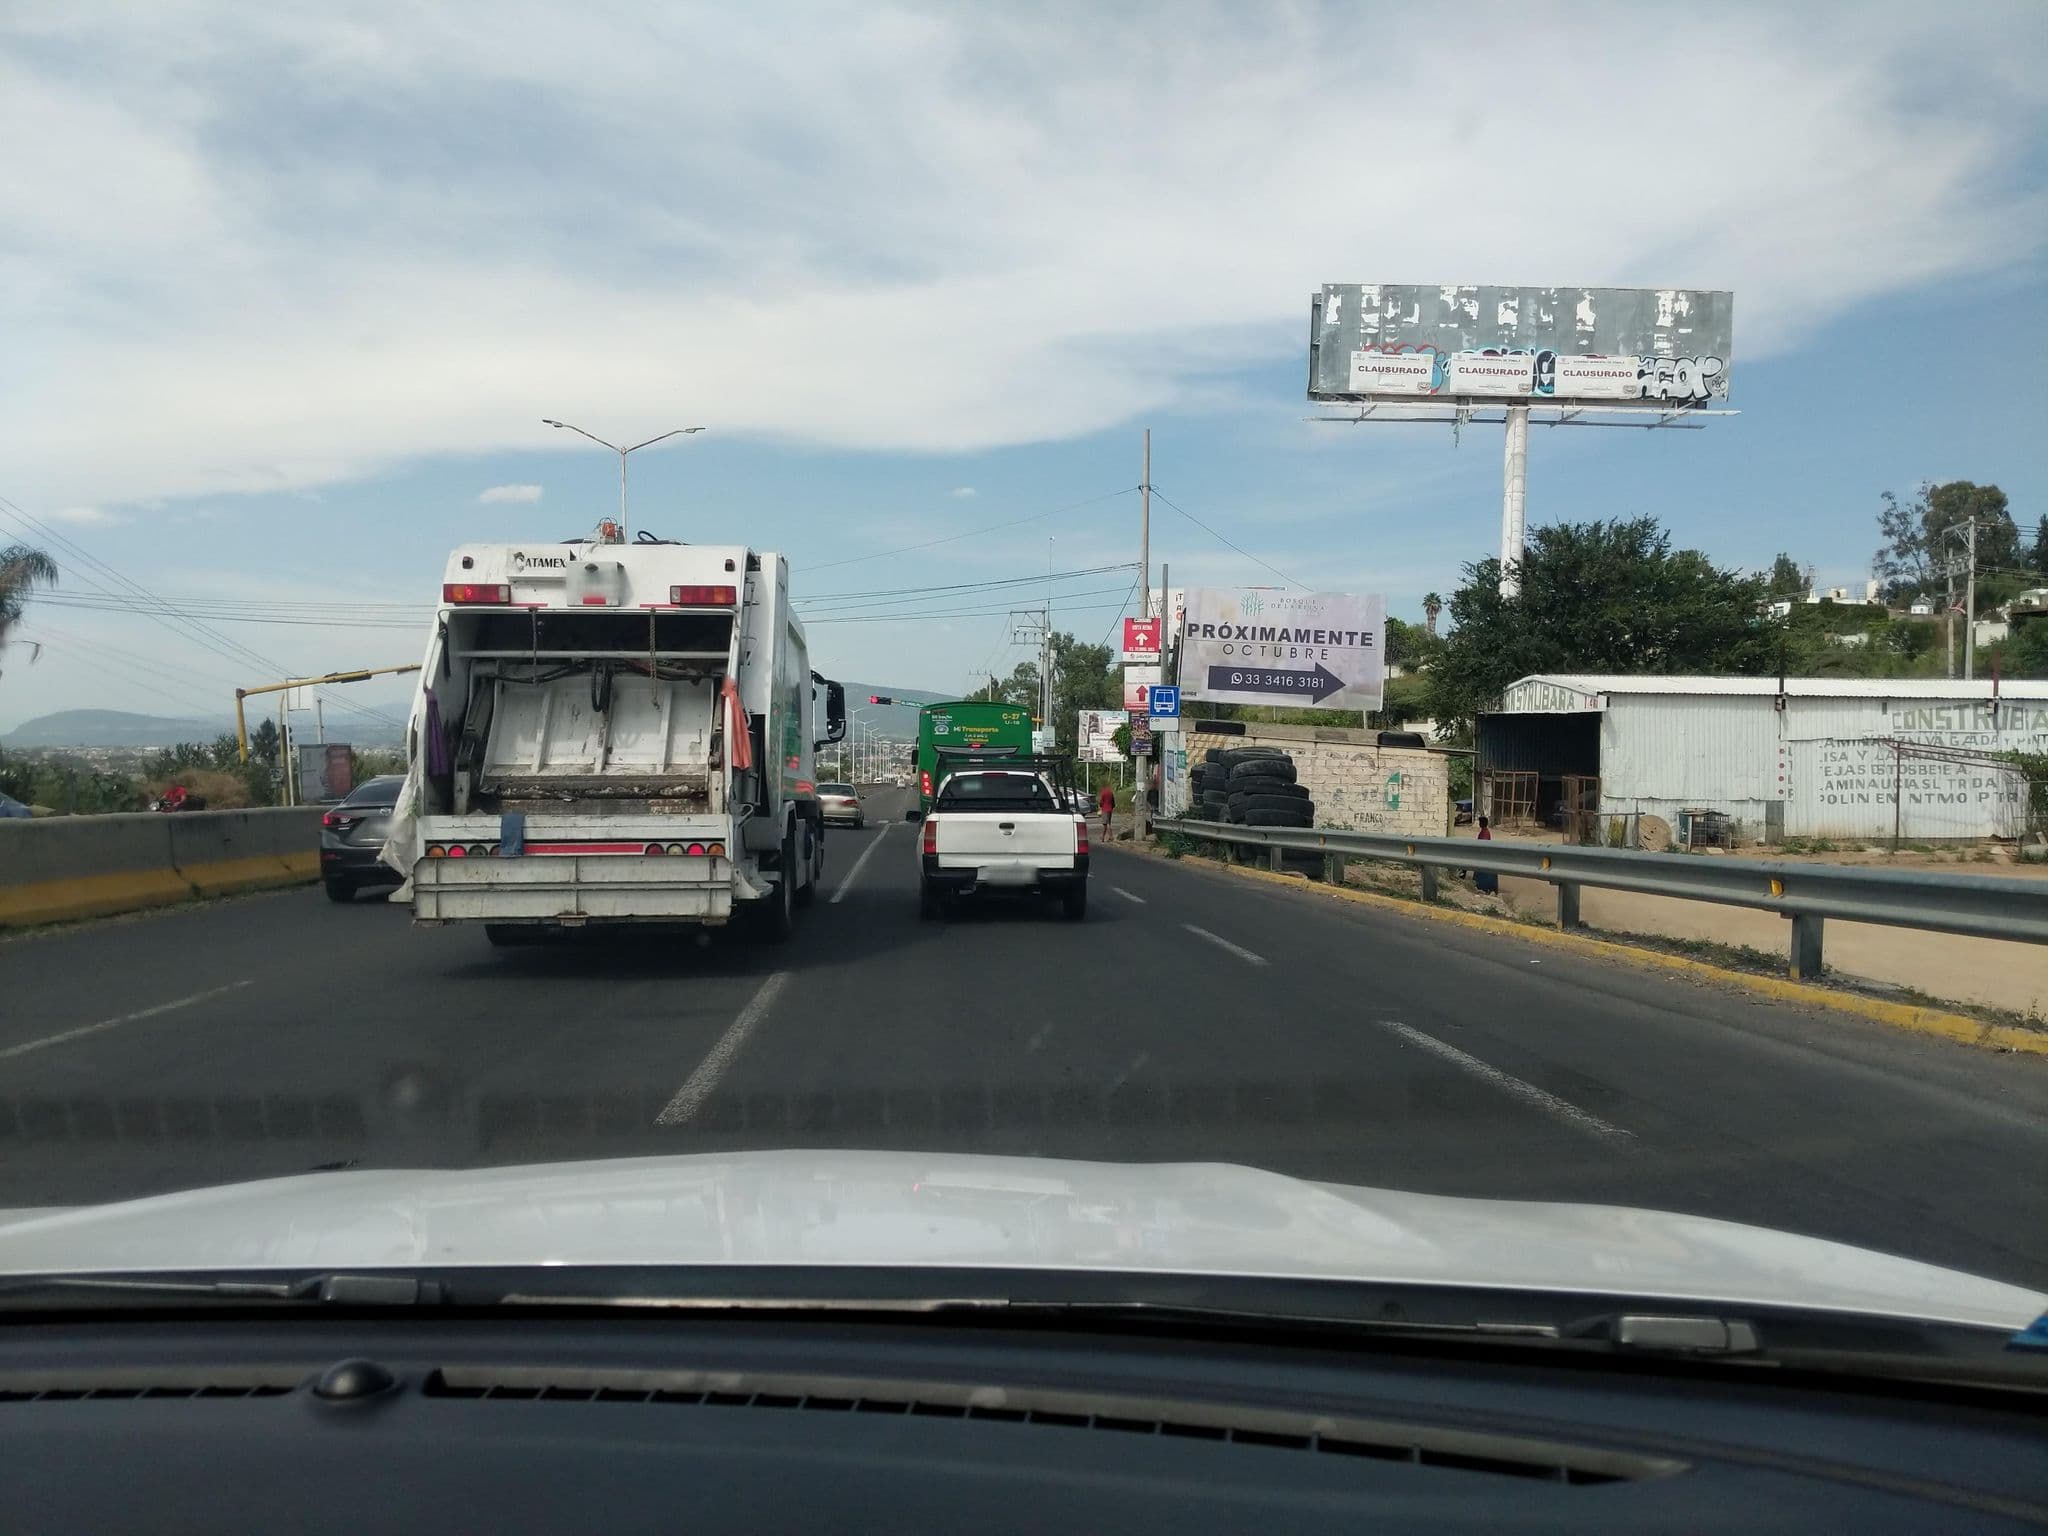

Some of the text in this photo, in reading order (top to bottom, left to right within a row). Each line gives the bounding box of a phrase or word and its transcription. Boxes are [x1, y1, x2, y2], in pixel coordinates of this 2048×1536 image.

[1358, 365, 1428, 375] CLAUSURADO
[1458, 366, 1528, 376] CLAUSURADO
[1562, 369, 1633, 378] CLAUSURADO
[1187, 621, 1374, 647] PRÓXIMAMENTE
[1222, 643, 1329, 660] OCTUBRE
[1245, 674, 1325, 689] 33 3416 3181
